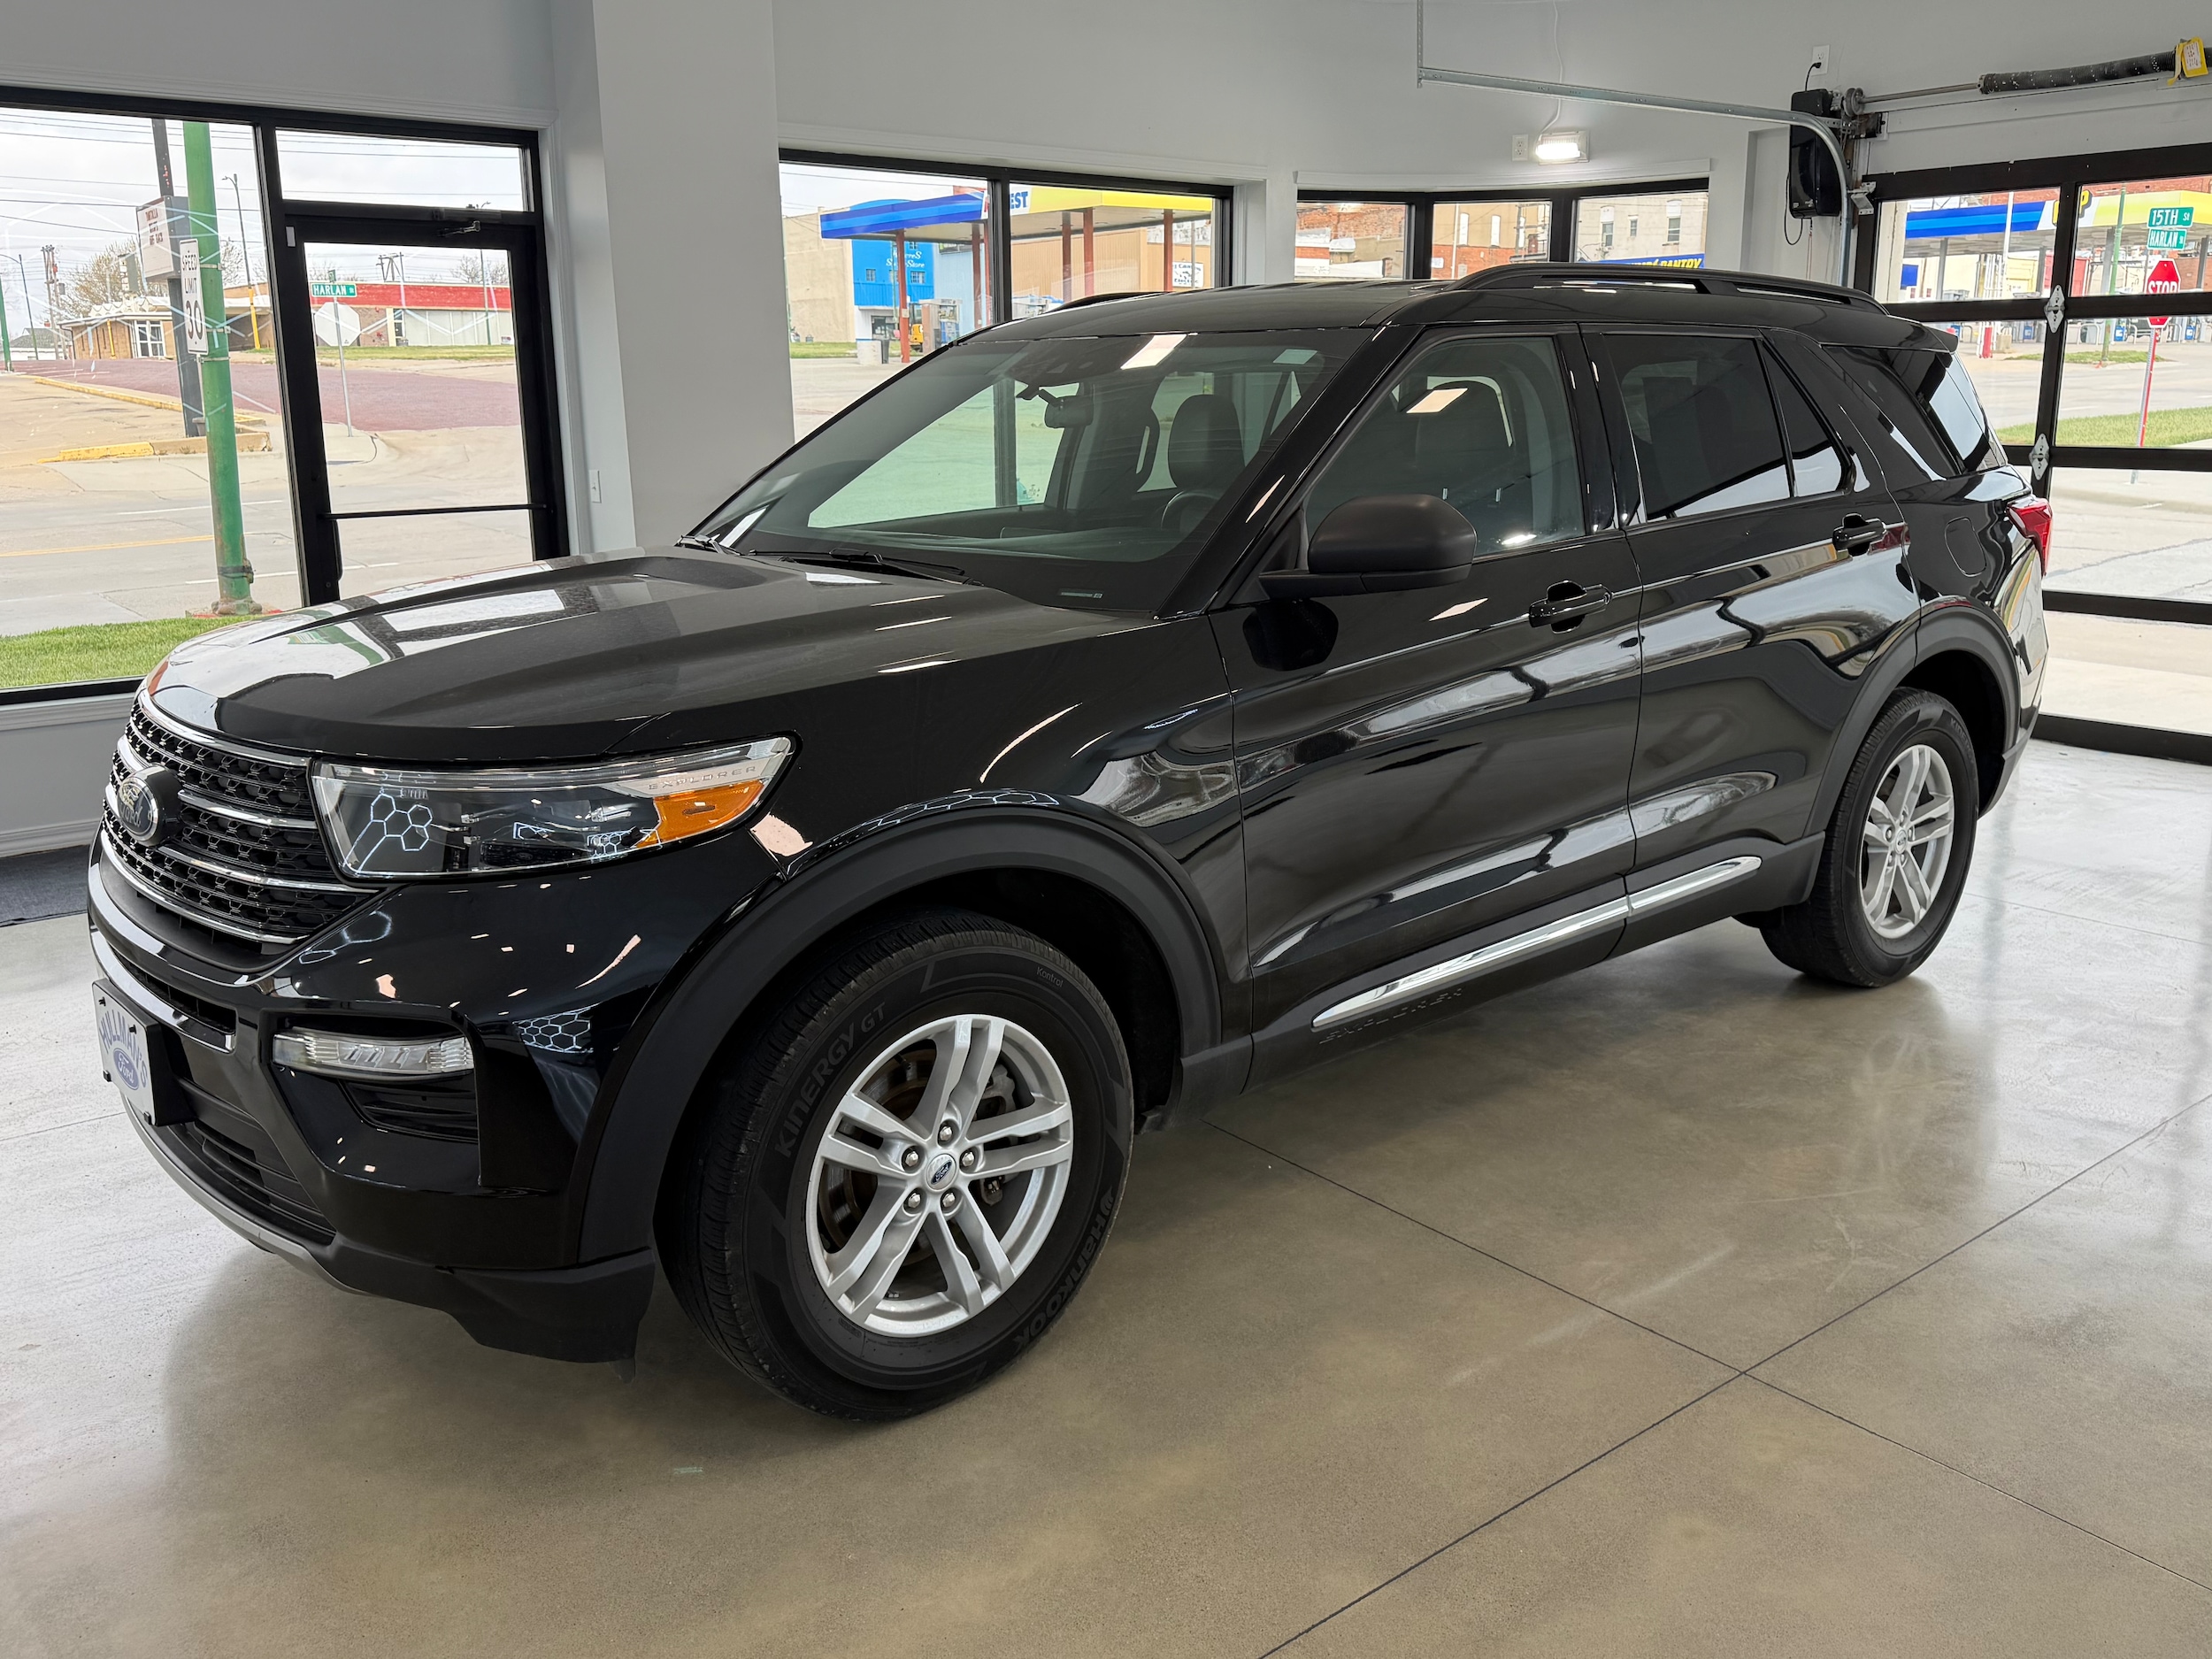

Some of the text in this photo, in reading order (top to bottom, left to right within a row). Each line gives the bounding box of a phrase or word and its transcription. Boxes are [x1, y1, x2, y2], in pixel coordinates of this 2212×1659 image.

[2152, 209, 2190, 226] 15TH St
[2149, 230, 2178, 248] HARLAN
[182, 254, 197, 271] SPEED
[184, 278, 197, 294] LIMIT
[313, 284, 347, 296] HARLAN
[186, 300, 203, 340] 30
[649, 766, 756, 790] EXPLORER
[1036, 966, 1064, 987] Kontrol
[99, 1010, 148, 1088] HULLMAN'S
[118, 1051, 134, 1084] Ford
[774, 1002, 885, 1158] KINERGY GT
